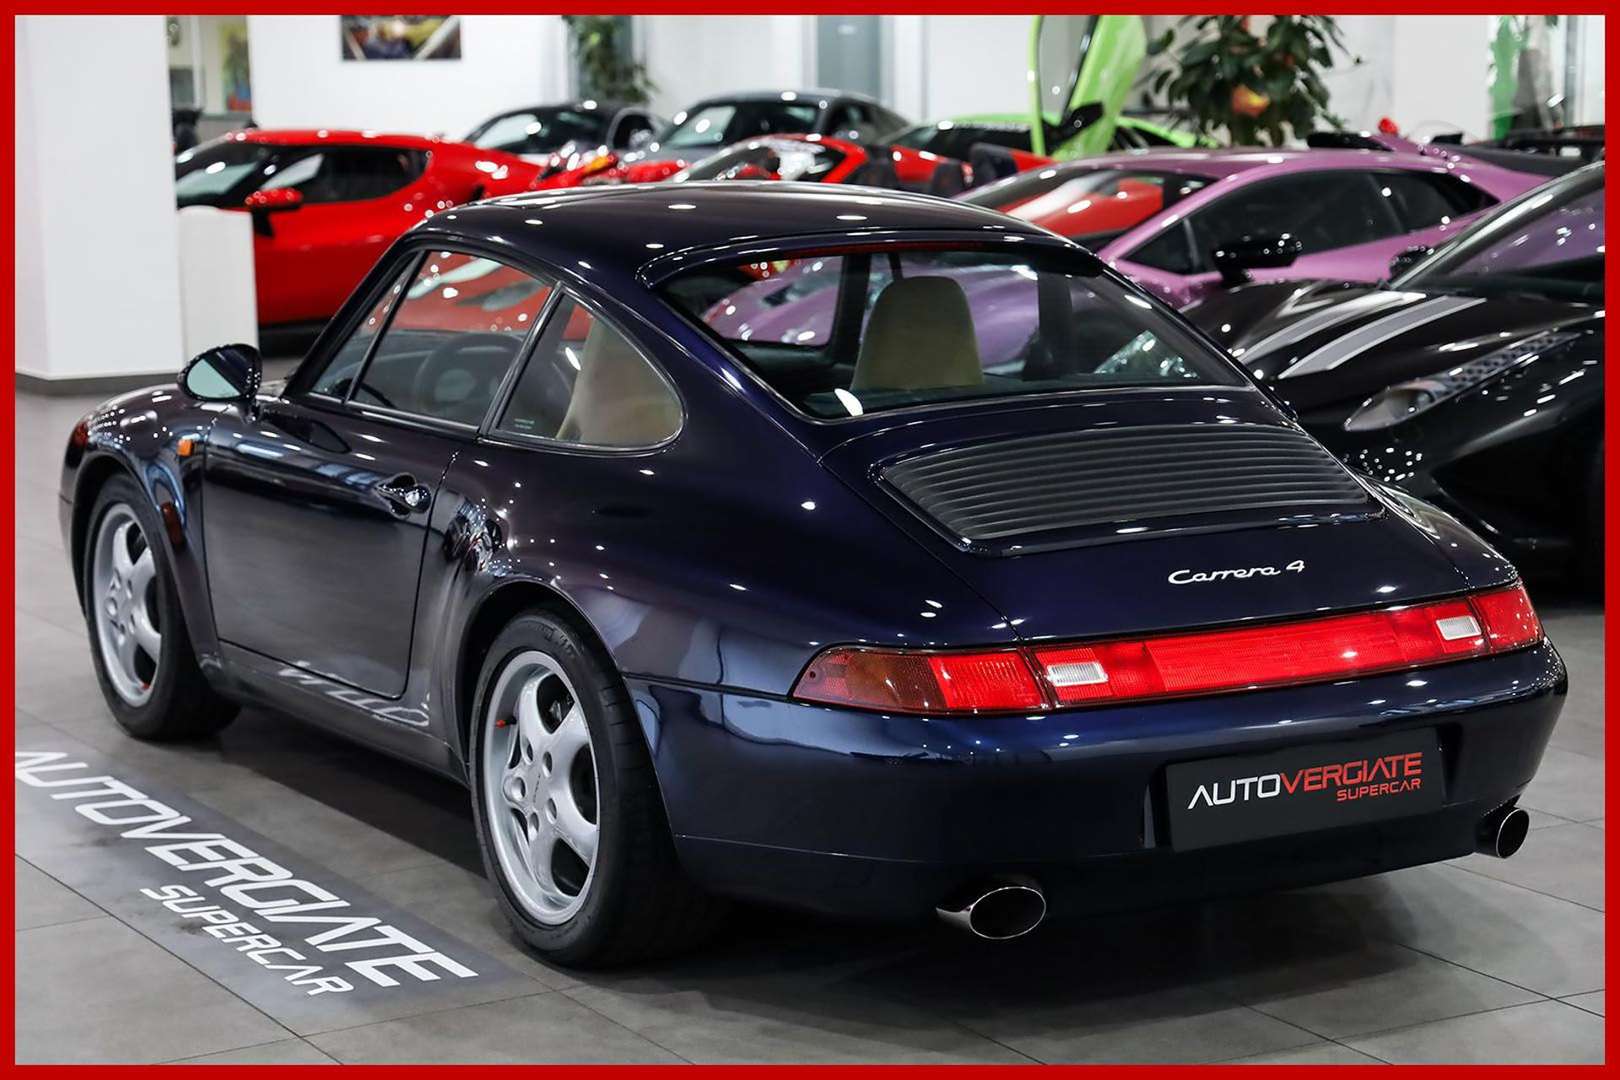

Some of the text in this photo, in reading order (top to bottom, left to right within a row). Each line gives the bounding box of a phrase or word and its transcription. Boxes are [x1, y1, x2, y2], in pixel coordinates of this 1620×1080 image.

[1168, 560, 1305, 585] Carrera 4
[1187, 752, 1423, 810] AUTOVERGIATE
[1336, 778, 1422, 802] SUPERCAR
[15, 751, 479, 988] AUTOVERGIATE
[139, 885, 354, 996] SUPERCAR
